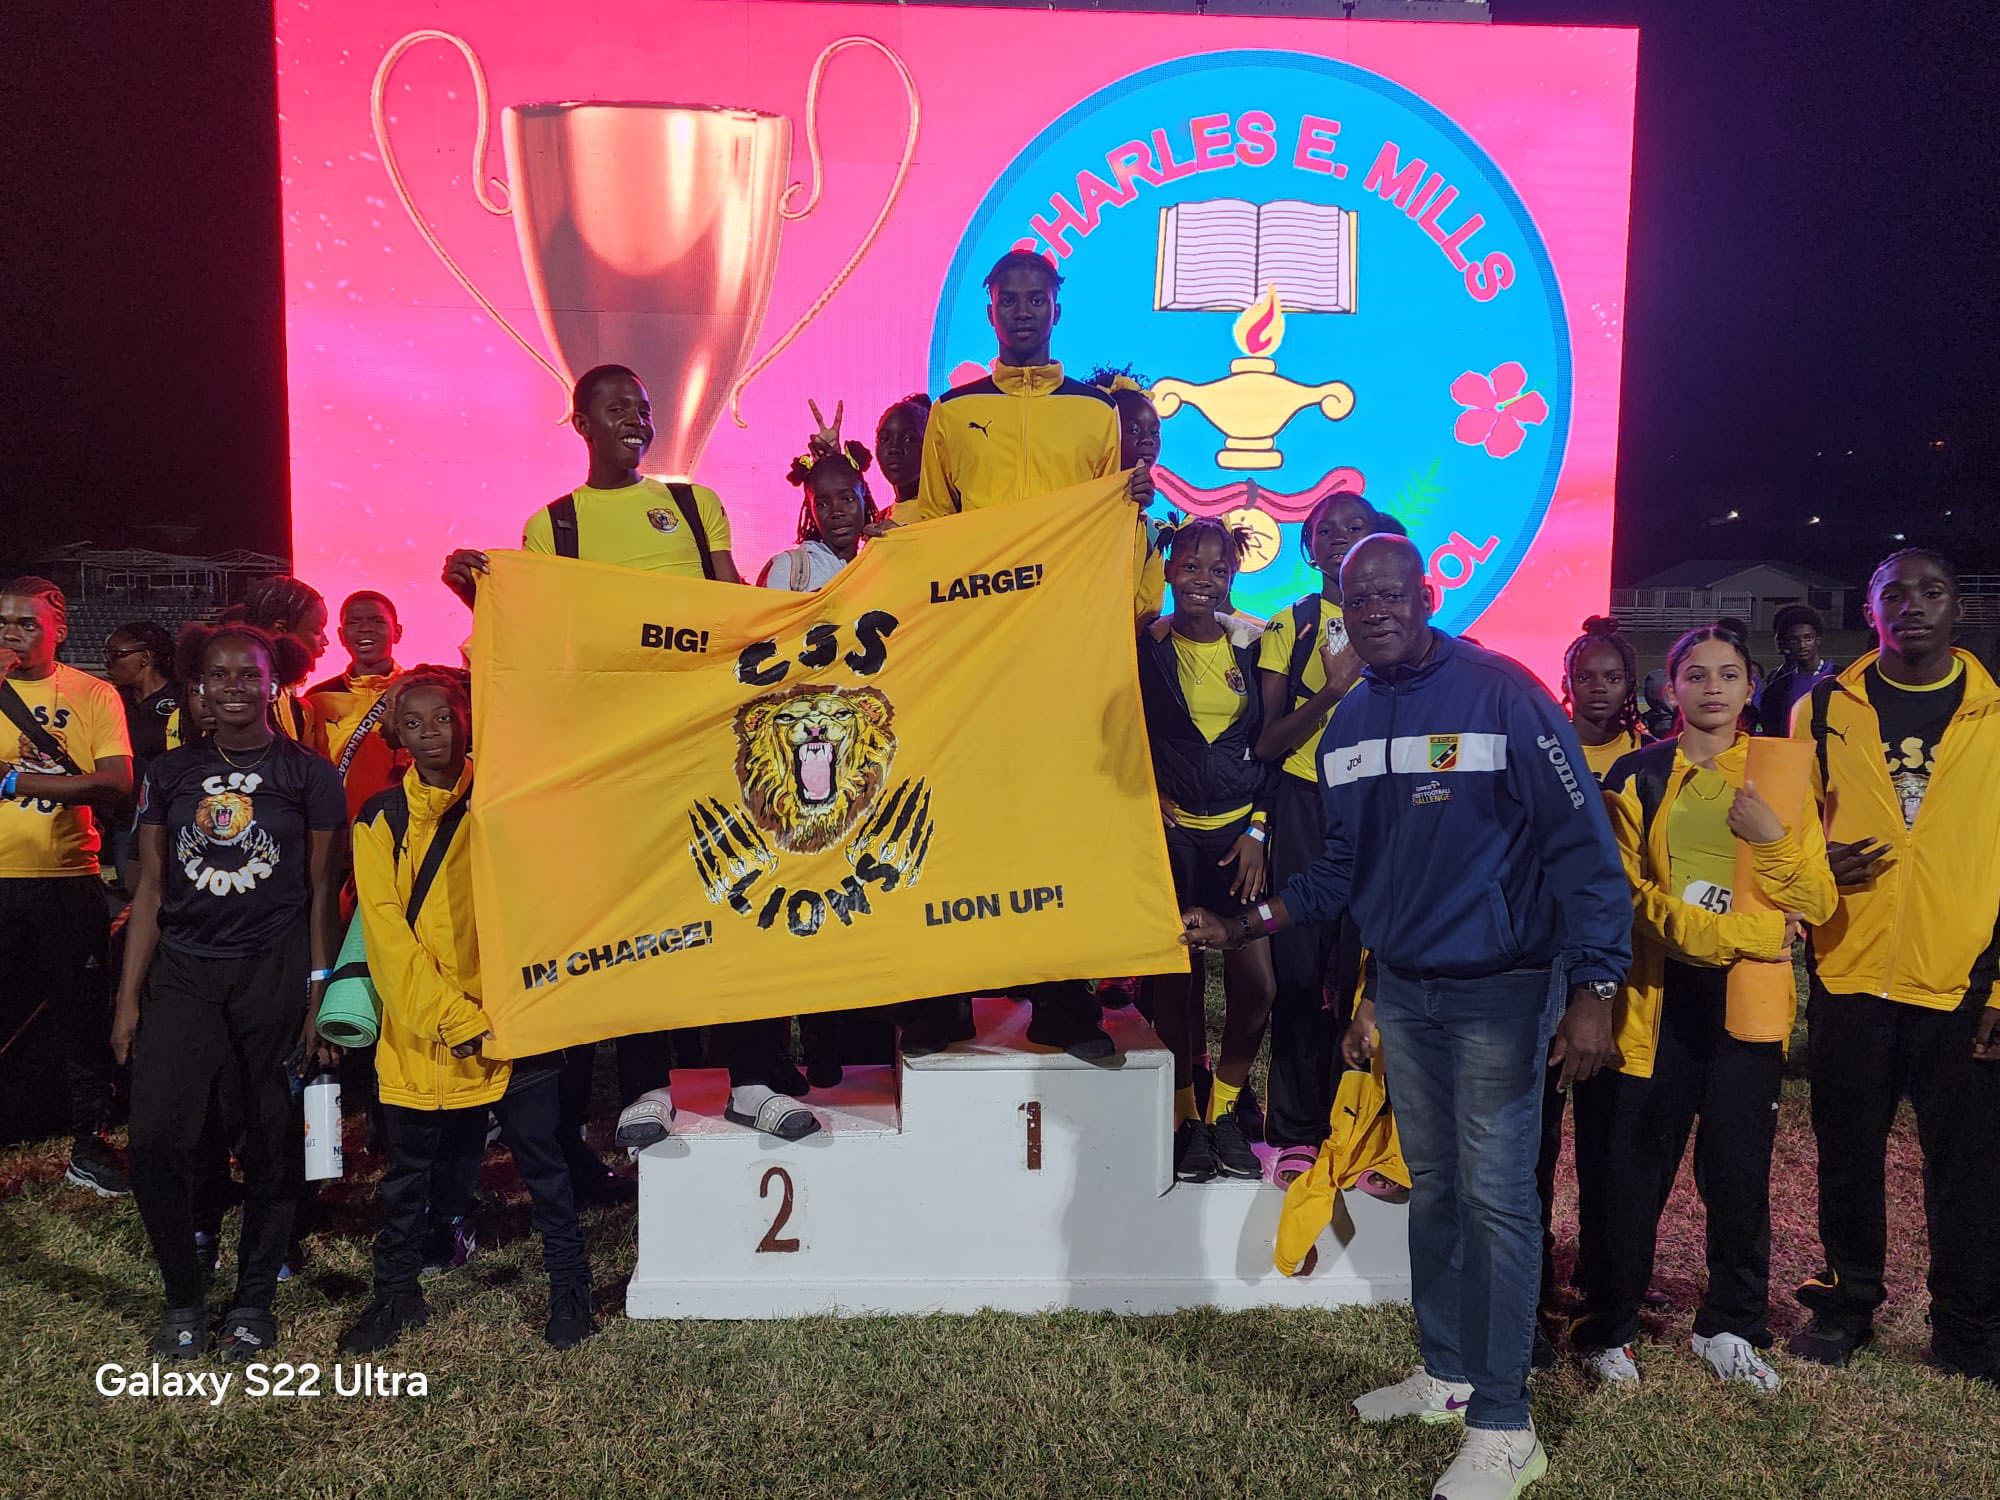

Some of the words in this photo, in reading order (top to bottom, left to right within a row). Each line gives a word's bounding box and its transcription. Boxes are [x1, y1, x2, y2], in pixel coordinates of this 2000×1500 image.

[1293, 114, 1349, 181] E.
[1362, 140, 1516, 303] MILLS
[929, 563, 1043, 604] LARGE!
[640, 623, 709, 653] BIG!
[733, 609, 900, 687] CSS
[202, 772, 263, 795] CSS
[184, 856, 273, 896] LIONS
[727, 852, 901, 937] LIONS
[925, 893, 1001, 927] LION
[1009, 885, 1064, 914] UP!
[521, 960, 559, 990] IN
[566, 920, 713, 976] CHARGE!
[1017, 1101, 1042, 1170] 1
[755, 1166, 800, 1253] 2
